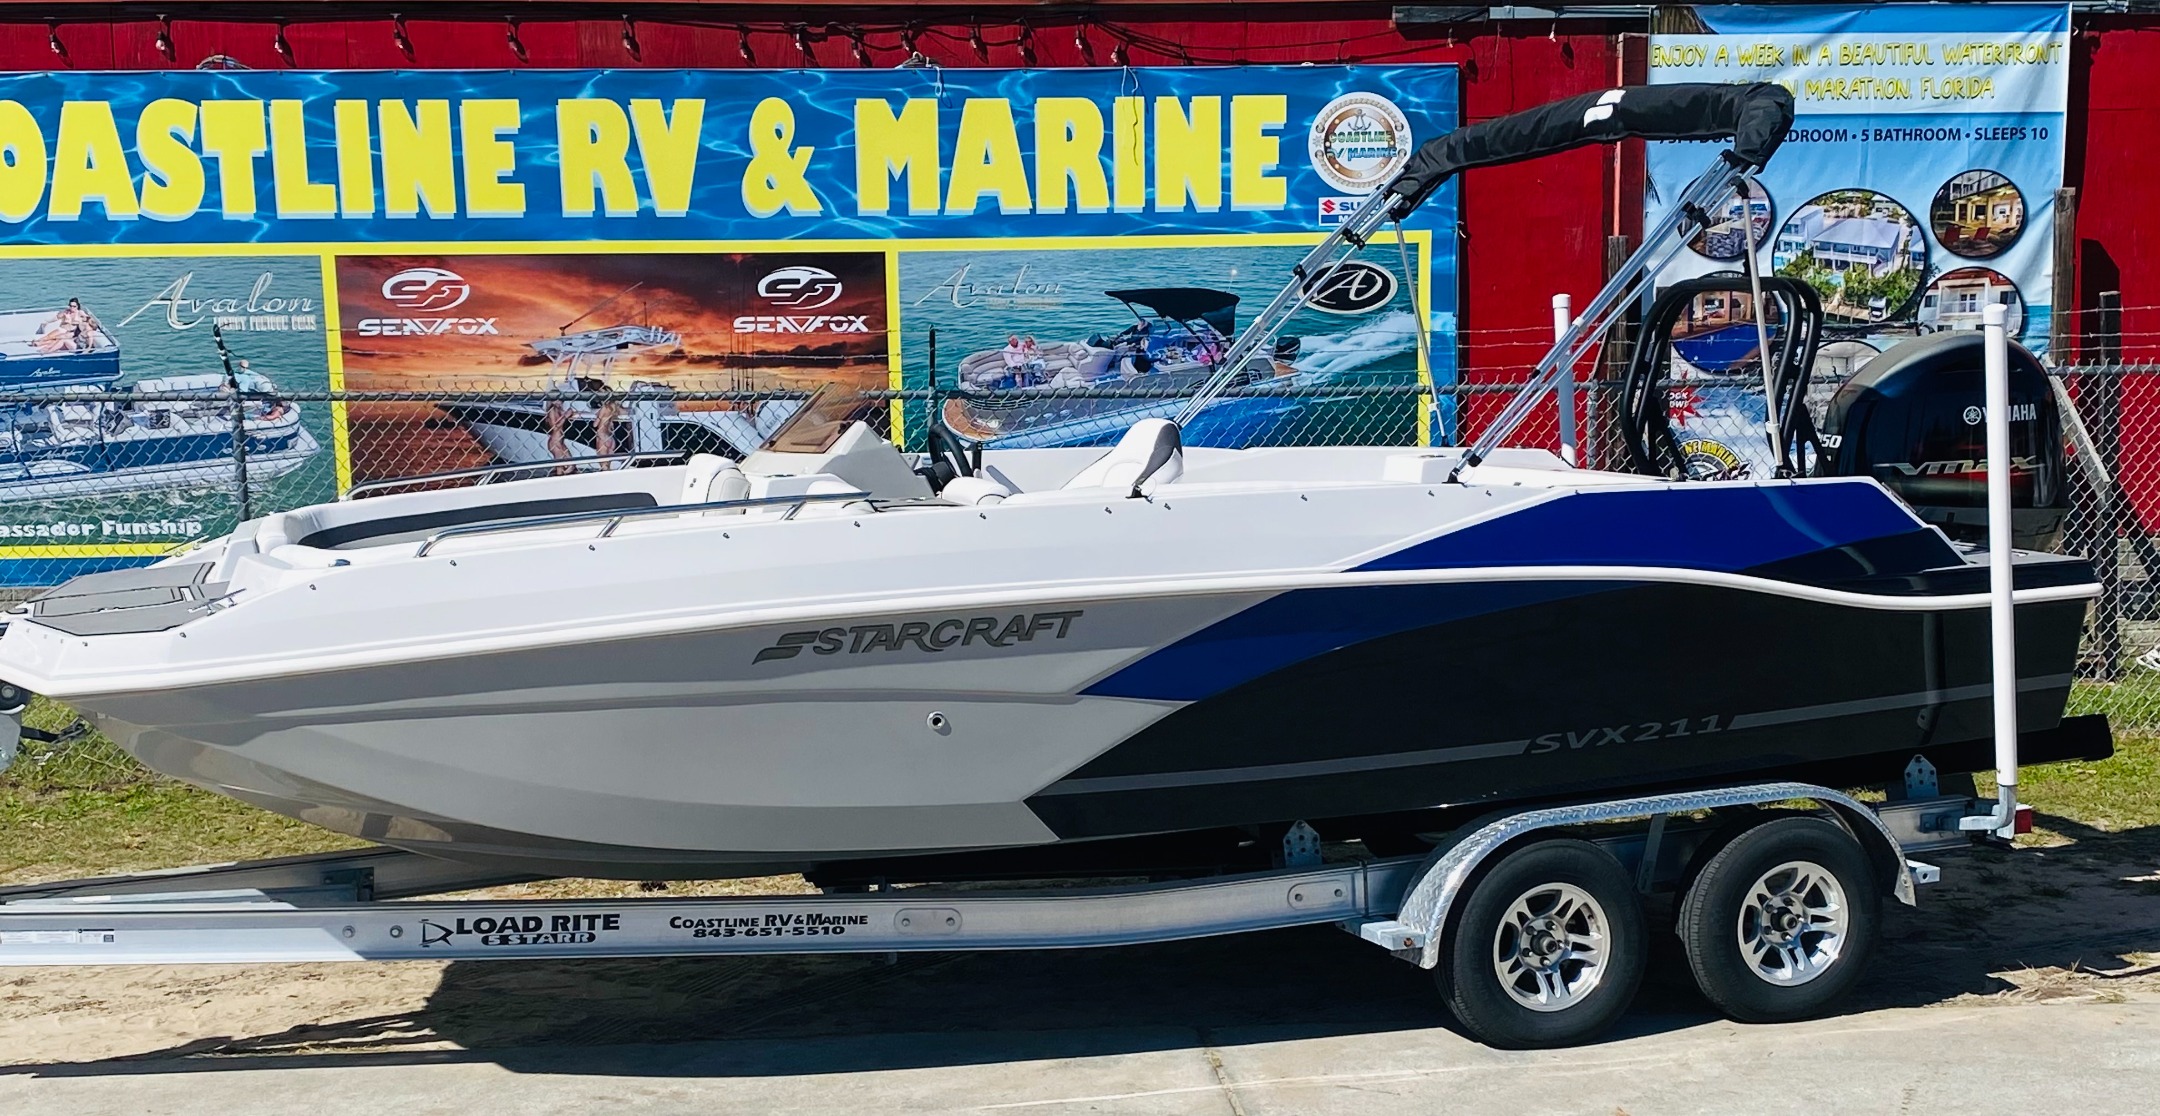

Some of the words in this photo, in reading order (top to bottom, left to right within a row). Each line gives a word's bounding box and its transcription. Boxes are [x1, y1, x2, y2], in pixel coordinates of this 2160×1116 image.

[1651, 44, 1709, 67] ENJOY
[1714, 44, 1729, 67] A
[1737, 44, 1784, 67] WEEK
[1792, 44, 1812, 67] IN
[1818, 43, 1832, 66] A
[1839, 42, 1934, 66] BEAUTIFUL
[1942, 42, 2064, 66] WATERFRONT
[1920, 76, 1995, 100] FLORIDA
[1860, 130, 1870, 142] 5
[1874, 128, 1961, 141] BATHROOM
[1974, 127, 2027, 140] SLEEPS
[2032, 127, 2049, 140] 10
[556, 98, 706, 218] RV
[741, 96, 824, 218] &
[854, 94, 1287, 216] MARINE
[914, 262, 1062, 308] Avalon
[116, 270, 313, 330] Avalon
[1982, 403, 2037, 421] AHA
[1820, 433, 1843, 448] 50
[102, 518, 201, 537] Funship
[812, 610, 1084, 655] STARCRAFT
[1531, 714, 1722, 754] SVX211
[456, 916, 543, 934] LOAD
[551, 913, 620, 932] RITE
[692, 926, 846, 938] 843-651-5510
[487, 934, 501, 946] 5
[507, 932, 590, 946] STARR
